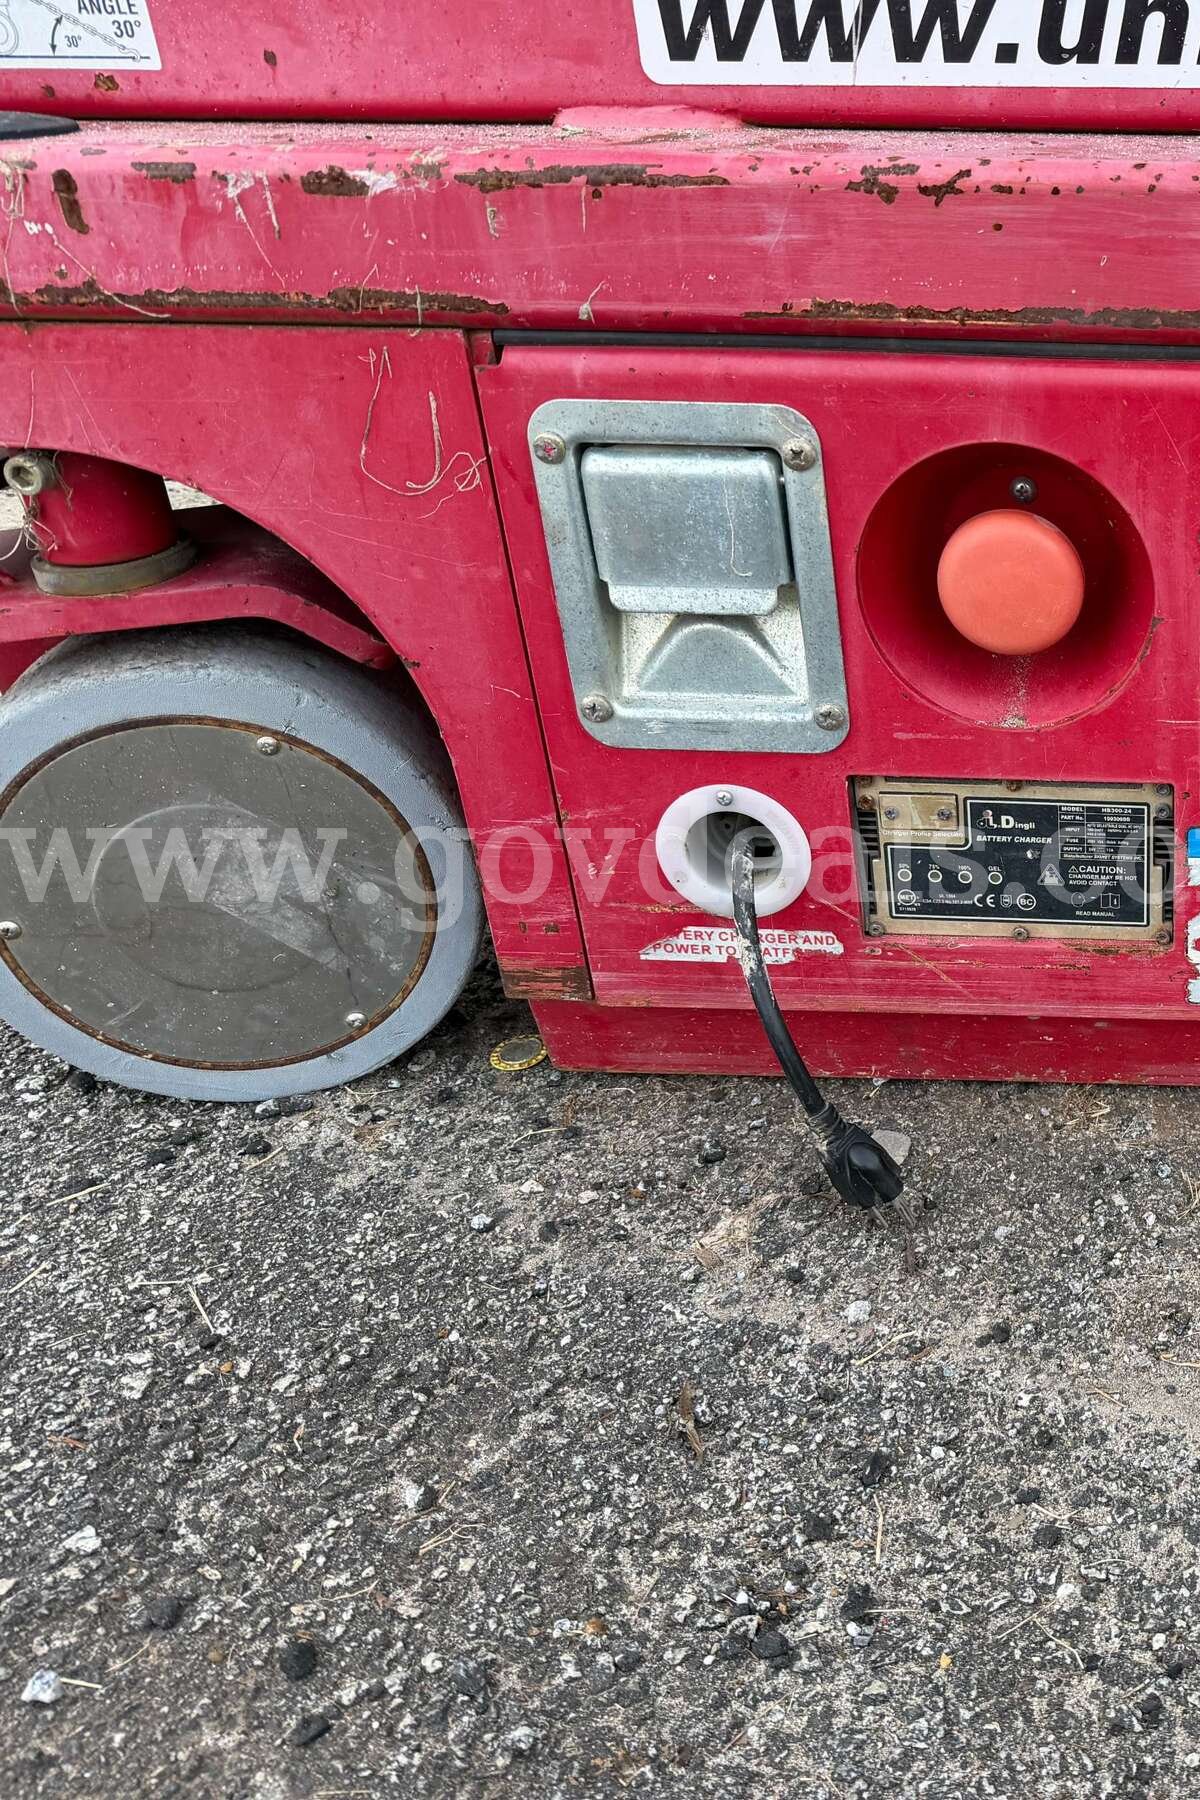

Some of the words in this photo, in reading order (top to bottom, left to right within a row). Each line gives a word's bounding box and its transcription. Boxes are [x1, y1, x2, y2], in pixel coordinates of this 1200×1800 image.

[78, 0, 139, 15] ANGLE
[976, 835, 1012, 843] BATTERY
[1014, 836, 1053, 844] CHARGER
[1078, 865, 1127, 874] CAUTION:
[718, 931, 798, 944] CHRGER
[801, 934, 836, 946] AND
[652, 943, 712, 955] POWER
[715, 944, 737, 956] TO
